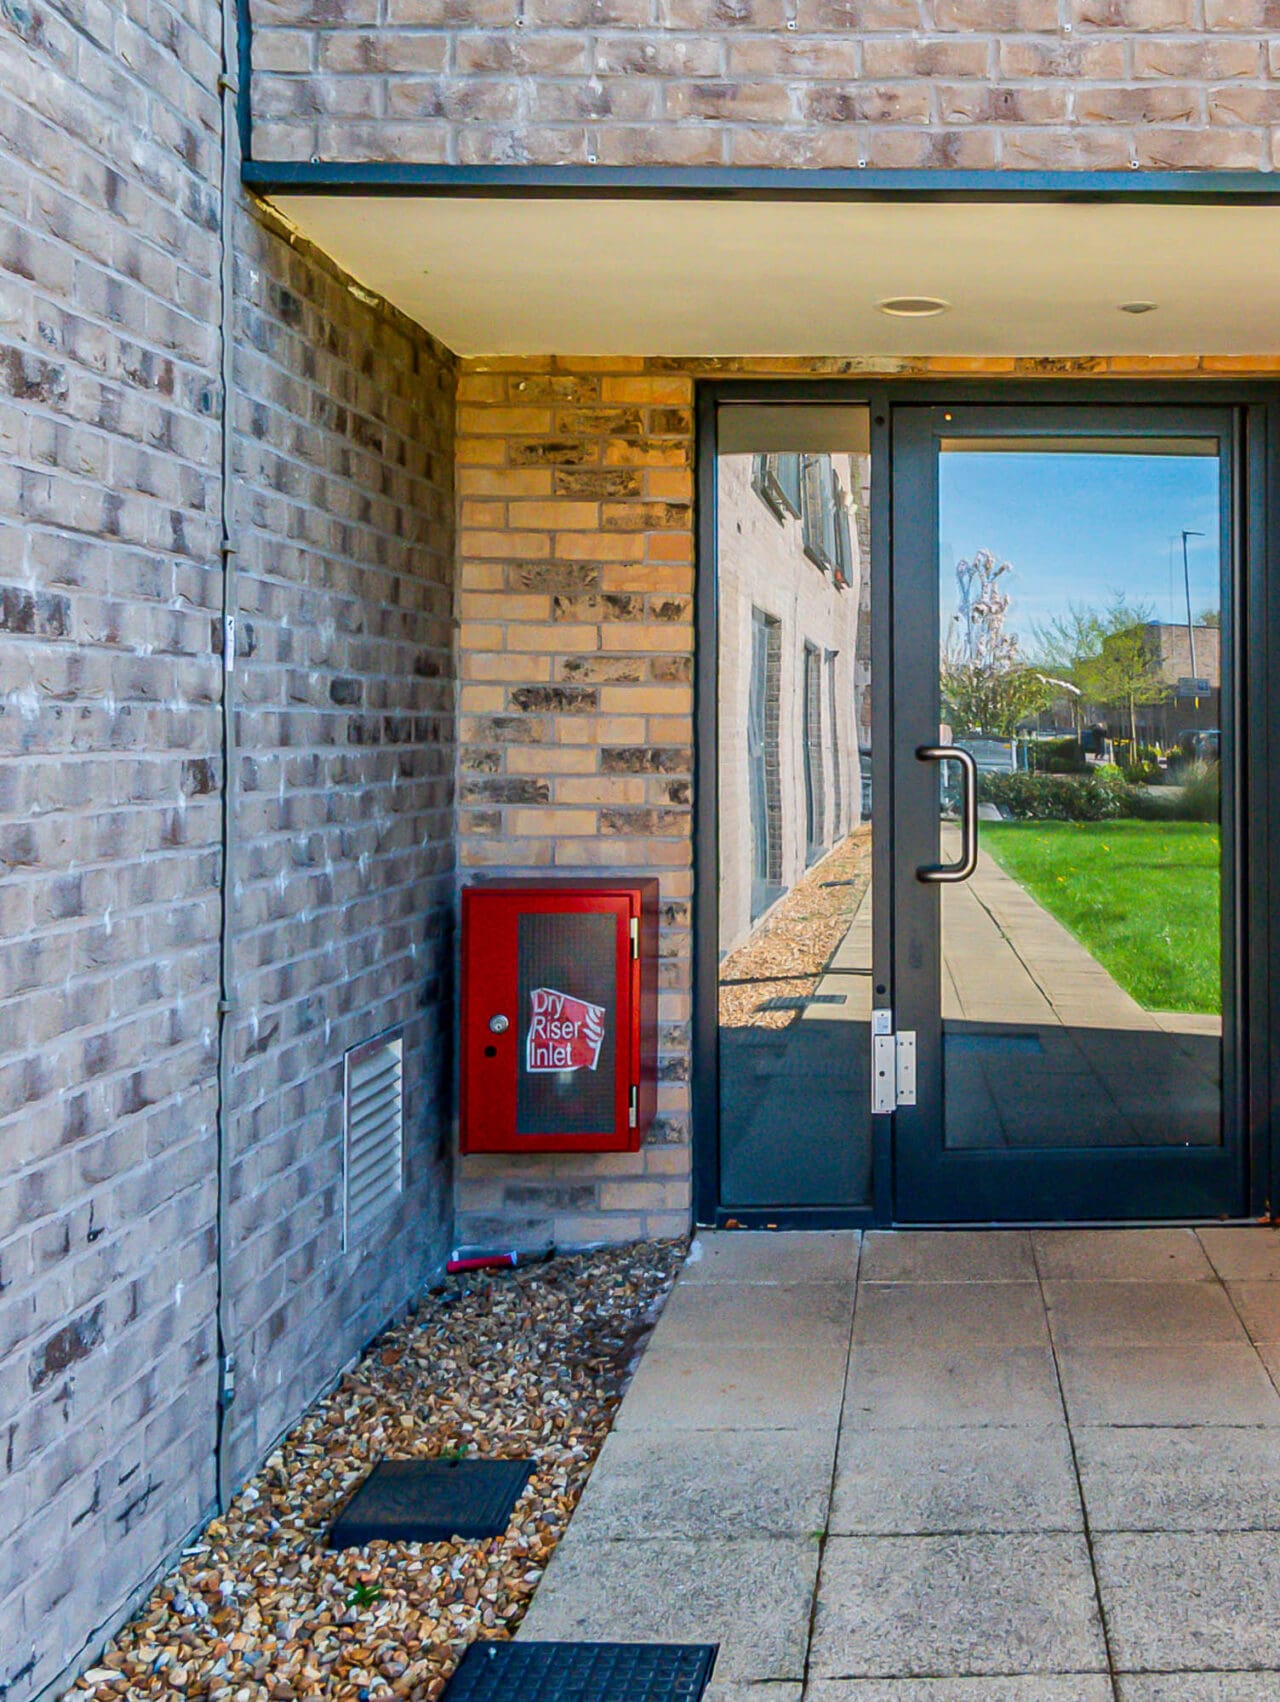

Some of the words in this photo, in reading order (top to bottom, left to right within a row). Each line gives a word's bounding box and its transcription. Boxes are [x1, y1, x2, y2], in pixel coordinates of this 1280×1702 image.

[533, 991, 565, 1020] Dry
[532, 1015, 582, 1040] Riser
[531, 1041, 573, 1066] Inlet
